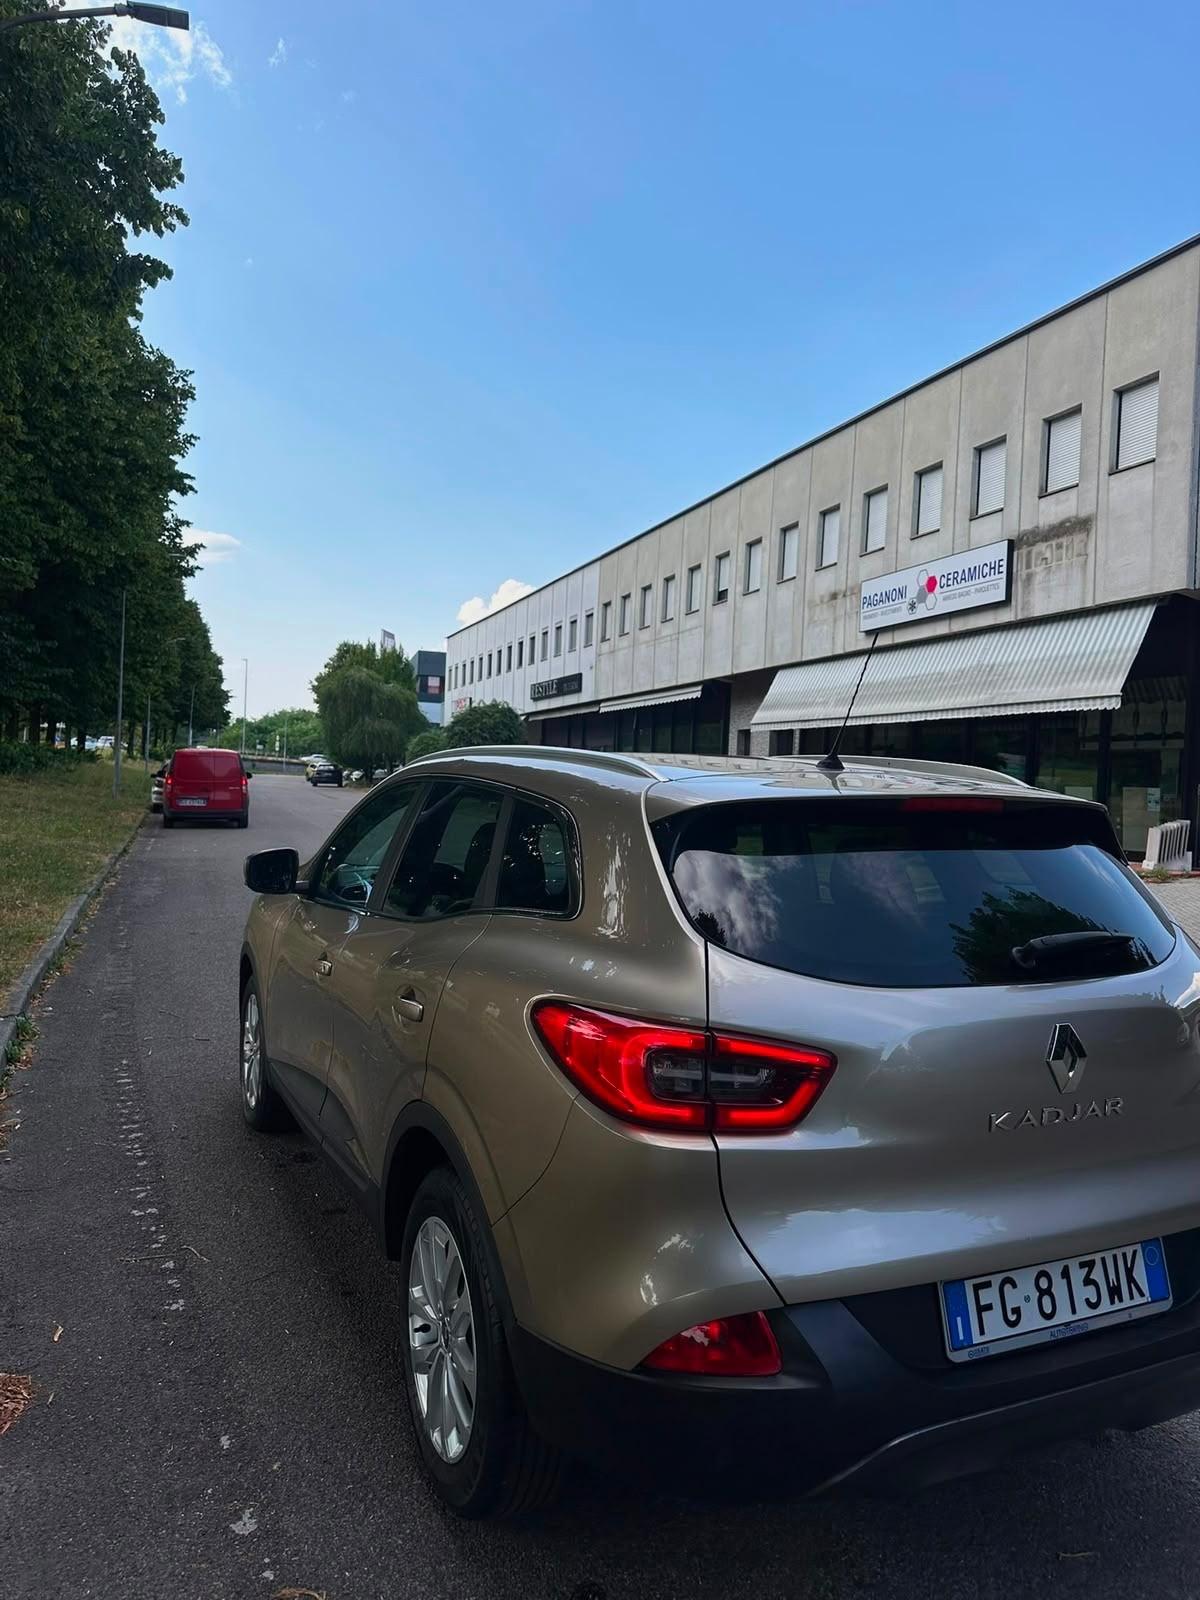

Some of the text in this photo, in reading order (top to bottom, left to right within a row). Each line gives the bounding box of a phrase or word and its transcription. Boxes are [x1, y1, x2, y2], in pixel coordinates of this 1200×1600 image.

[862, 559, 1004, 609] PAGANONI CERAMICHE
[988, 1097, 1124, 1133] KADJAR
